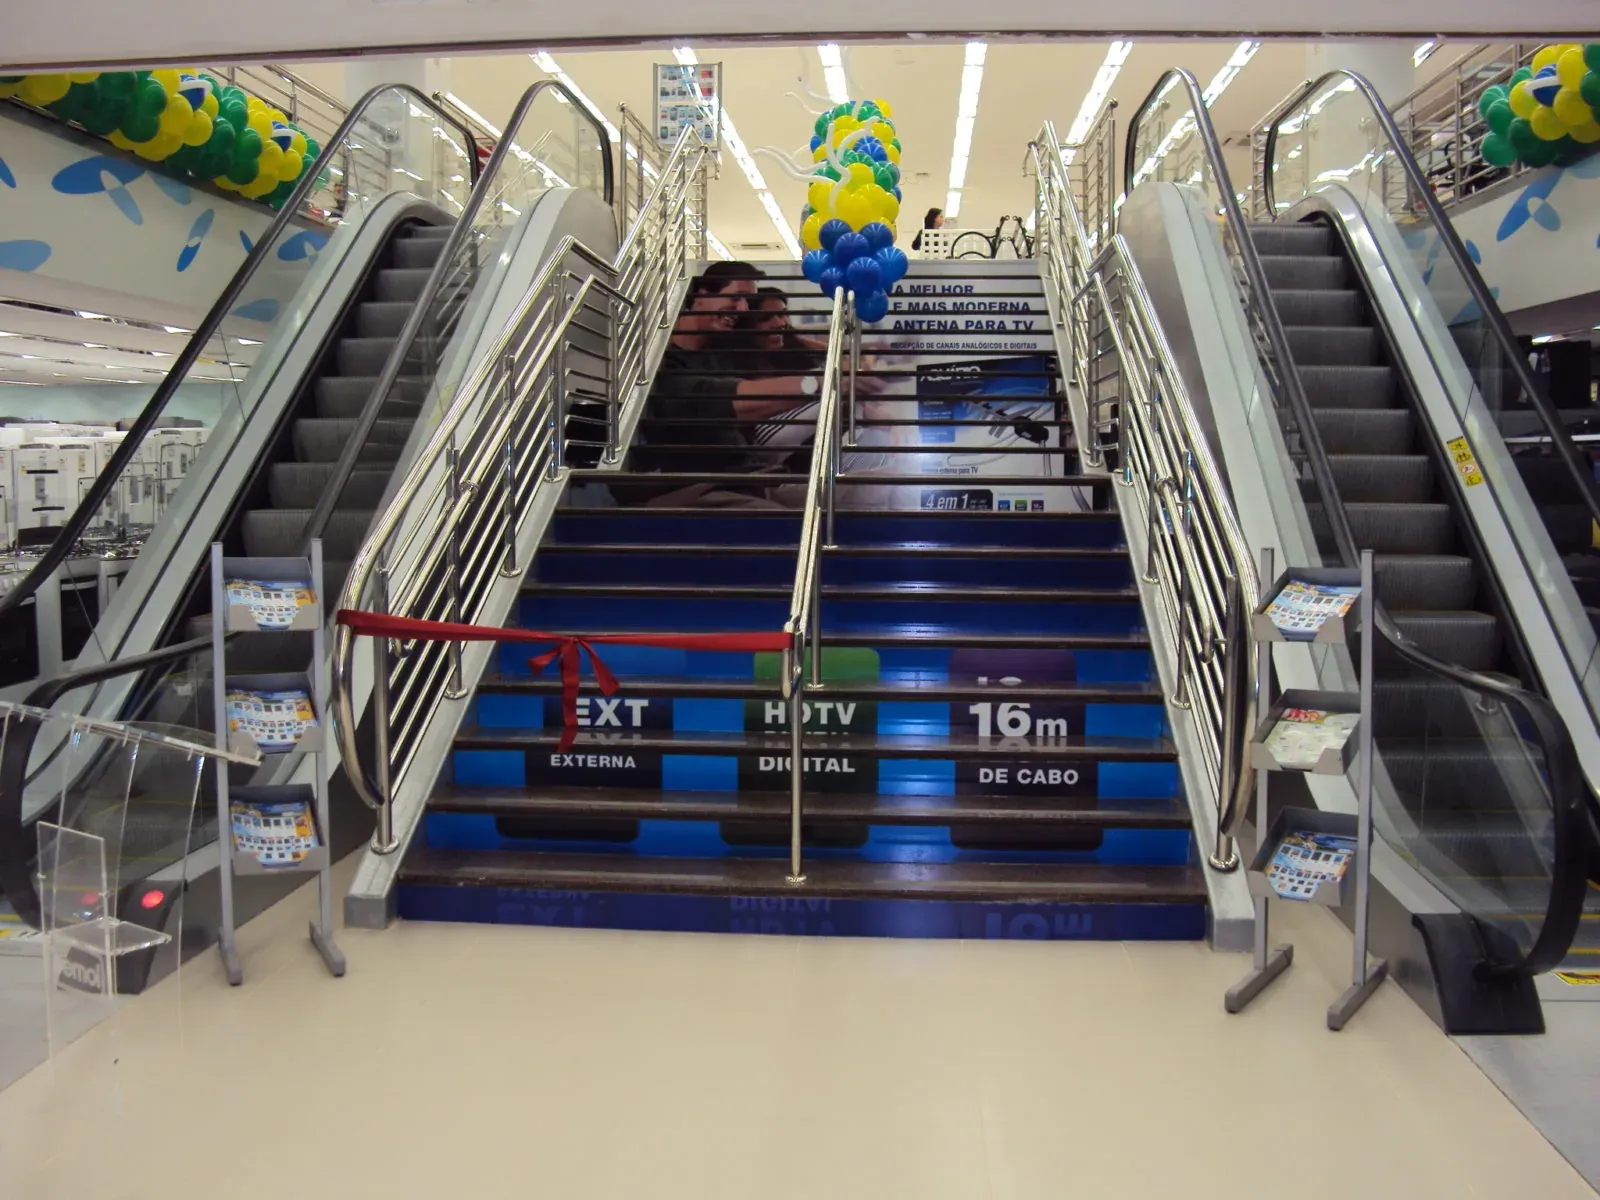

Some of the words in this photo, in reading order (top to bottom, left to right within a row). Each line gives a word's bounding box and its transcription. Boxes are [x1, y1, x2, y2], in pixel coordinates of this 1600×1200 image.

[895, 284, 904, 294] A
[909, 284, 974, 294] MELHOR
[908, 301, 948, 311] MAIS
[952, 301, 1031, 311] MODERNA
[893, 320, 959, 331] ANTENA
[965, 320, 1007, 331] PARA
[1012, 320, 1034, 331] TV
[926, 493, 935, 509] 4
[937, 496, 958, 510] em
[961, 493, 969, 510] 1
[576, 698, 649, 727] EXT
[550, 754, 636, 769] EXTERNA
[979, 768, 1009, 784] DE
[1016, 768, 1079, 785] CABO
